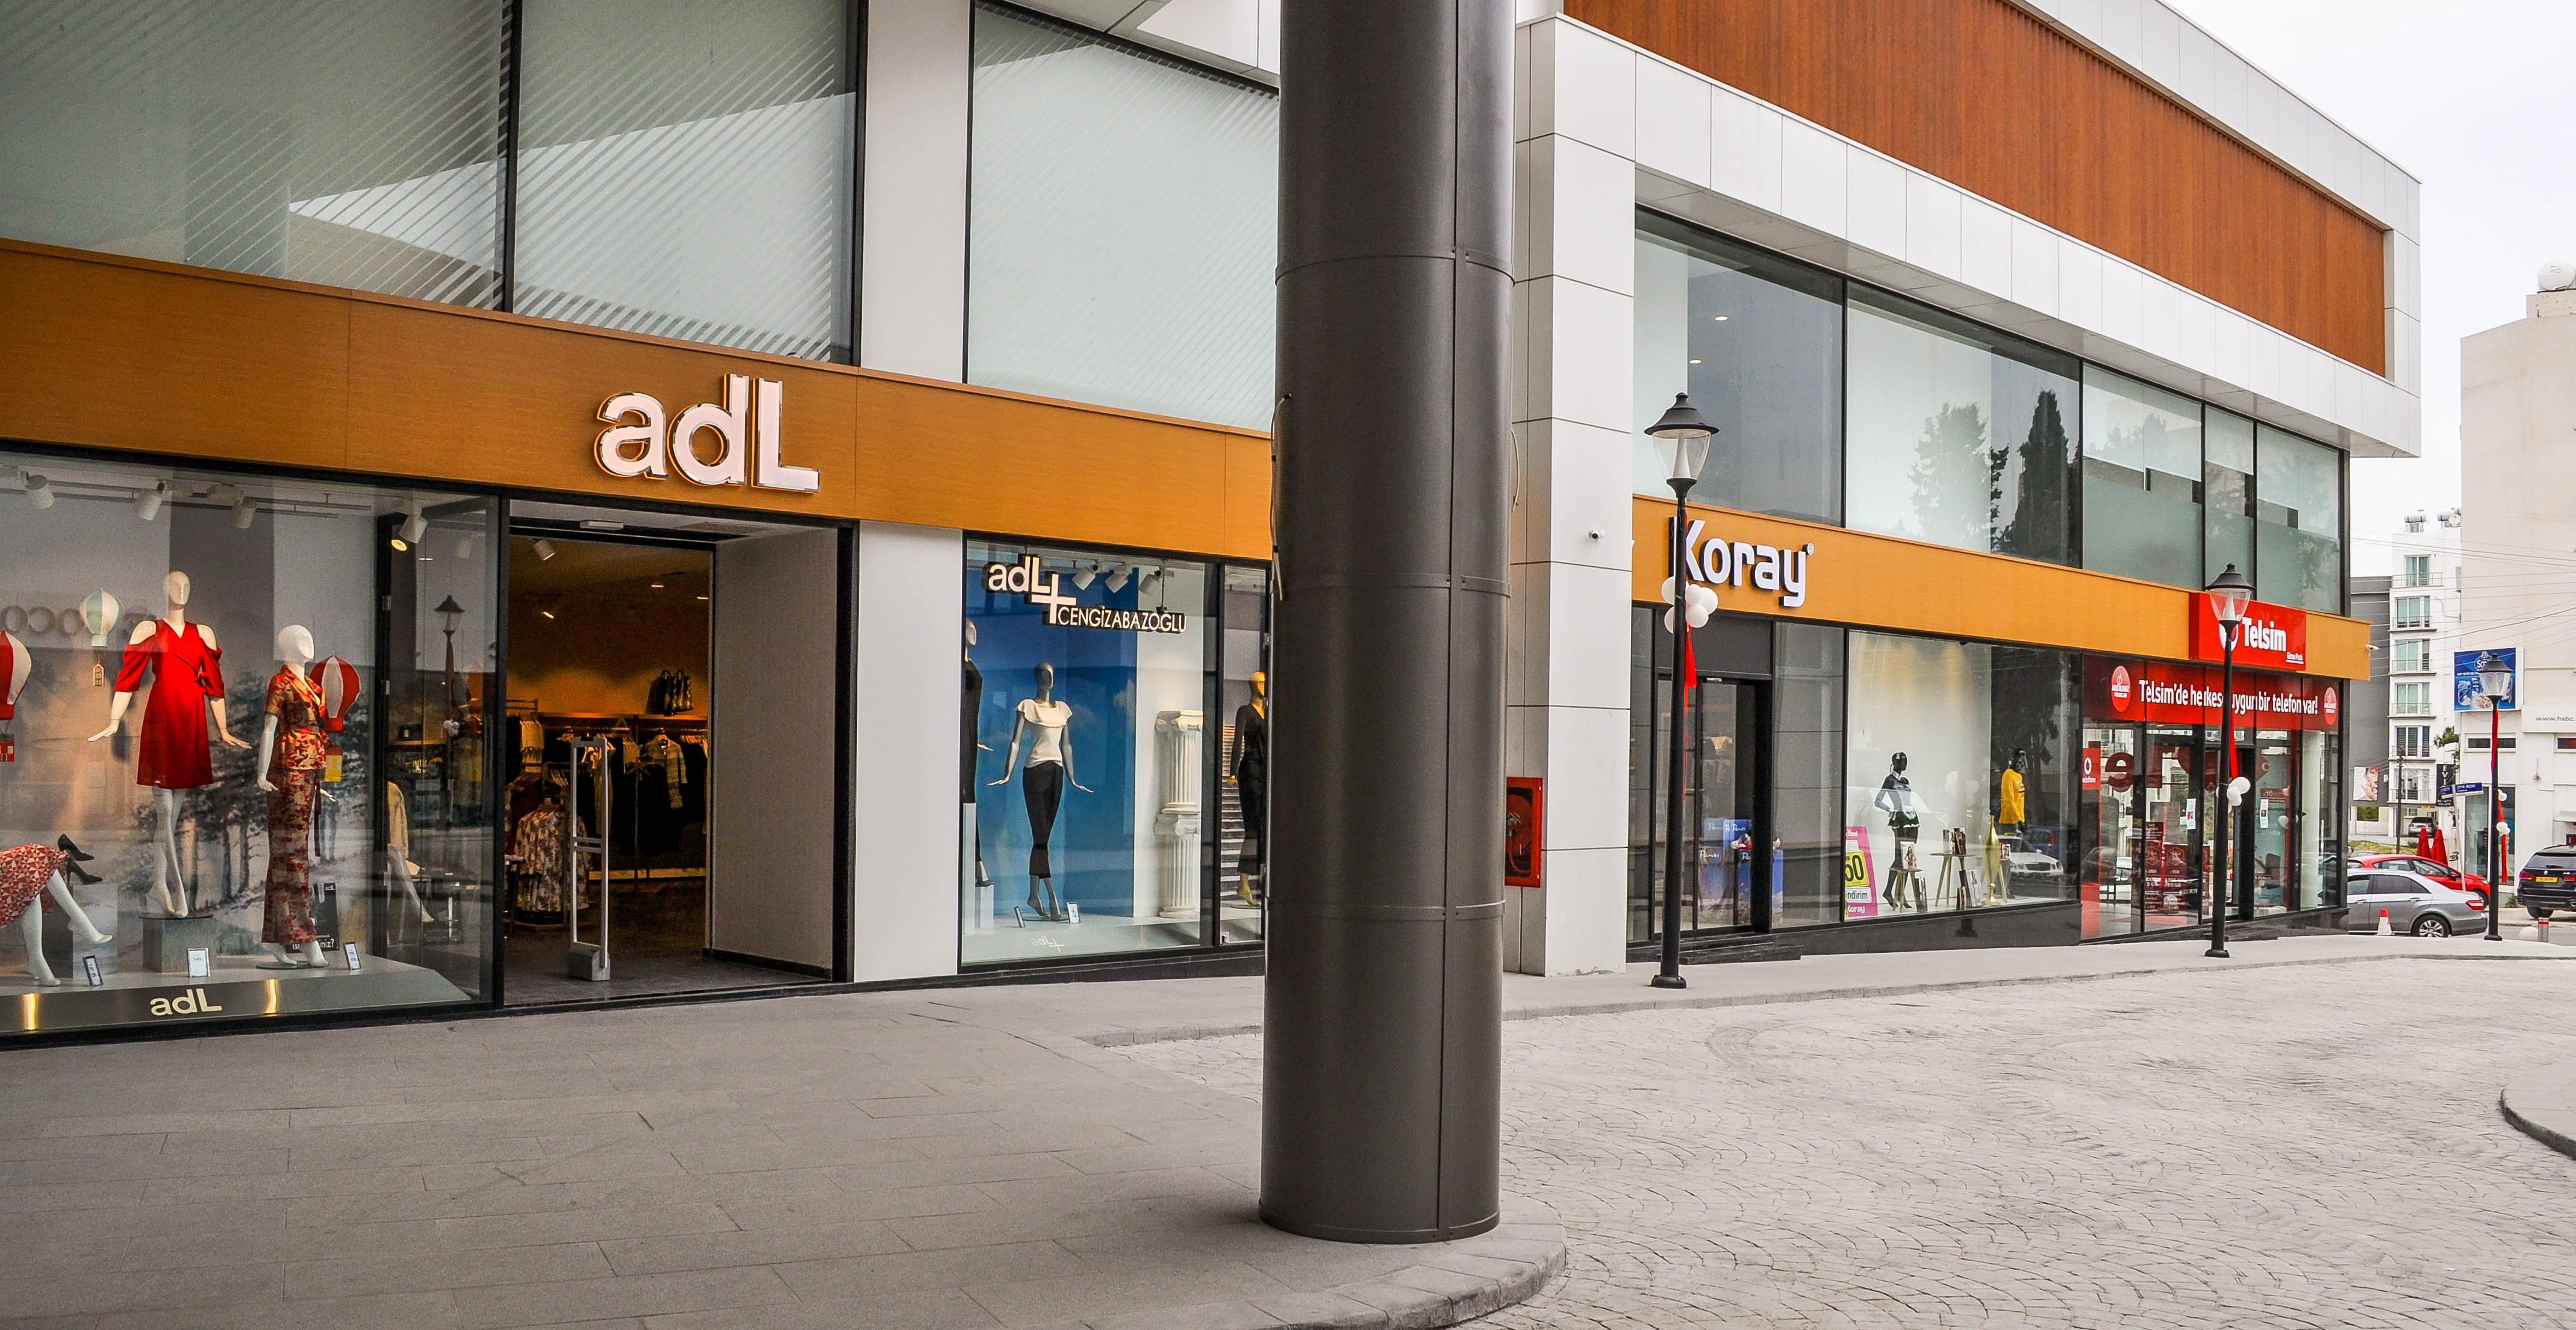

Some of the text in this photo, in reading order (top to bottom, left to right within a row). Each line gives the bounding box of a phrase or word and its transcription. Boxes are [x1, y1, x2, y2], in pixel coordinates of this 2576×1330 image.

[594, 373, 820, 493] adL
[1673, 516, 1806, 607] Koray
[2242, 617, 2287, 652] Telsim
[2259, 691, 2271, 711] bir
[2272, 693, 2301, 713] telefon
[2303, 695, 2318, 714] var!
[149, 988, 222, 1017] adL
